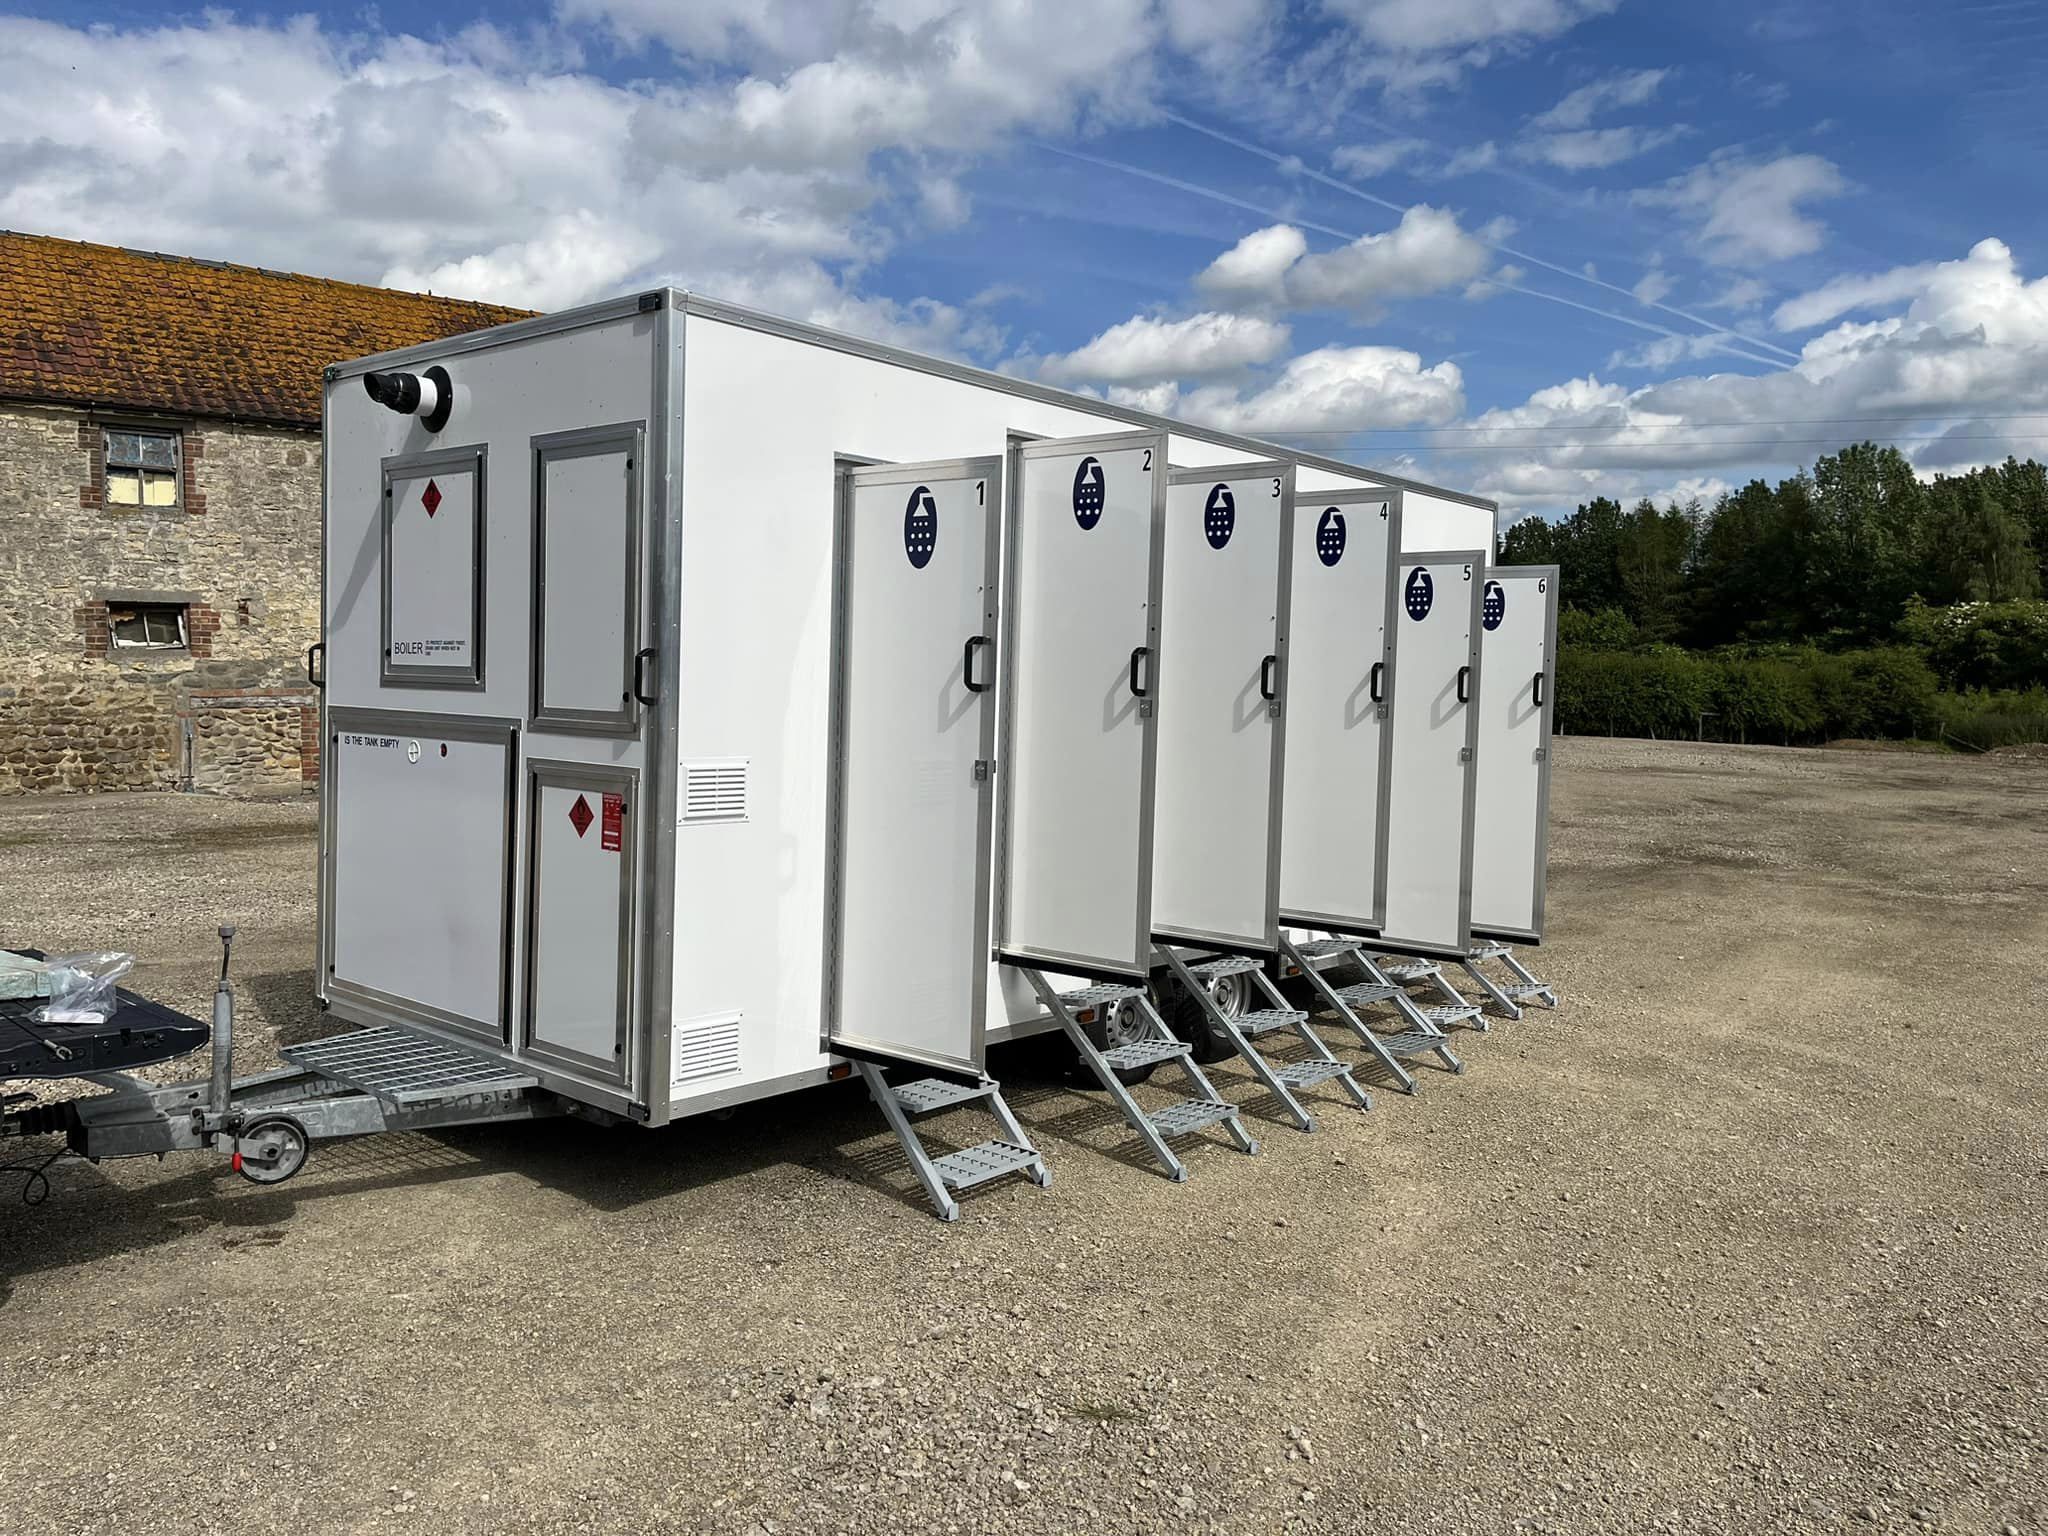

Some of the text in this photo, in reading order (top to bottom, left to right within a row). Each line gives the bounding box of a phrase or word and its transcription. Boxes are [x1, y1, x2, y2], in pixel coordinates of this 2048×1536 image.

[1142, 449, 1151, 472] 2
[975, 480, 985, 506] 1
[1271, 478, 1281, 498] 3
[1379, 502, 1388, 521] 4
[1463, 564, 1471, 581] 5
[1538, 578, 1546, 594] 6
[394, 642, 424, 655] BOILER
[344, 735, 400, 749] IS THE TANK EMPTY
